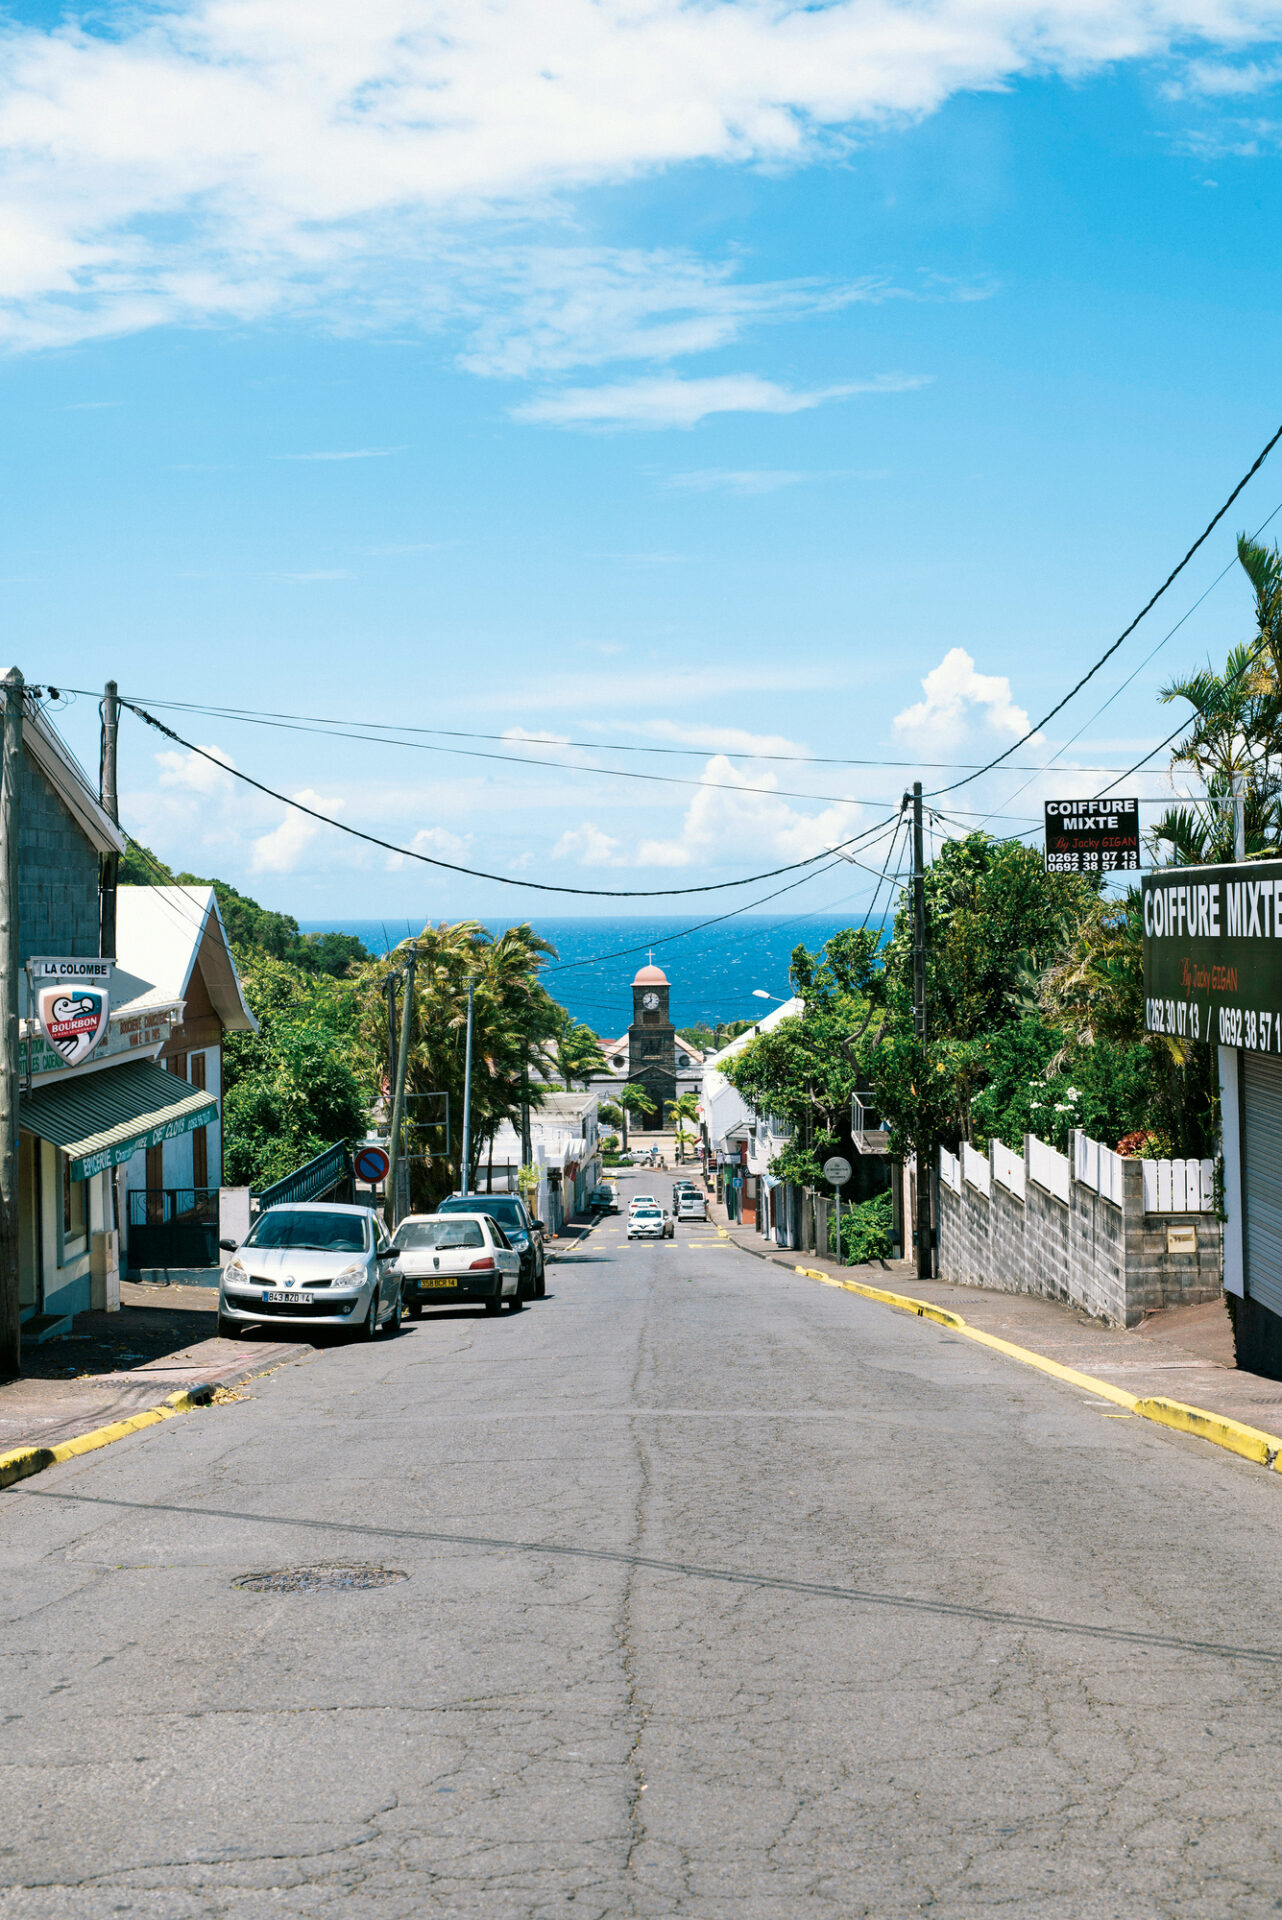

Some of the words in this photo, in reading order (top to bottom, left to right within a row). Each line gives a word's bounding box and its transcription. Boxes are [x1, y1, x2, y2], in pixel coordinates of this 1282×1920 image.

[1047, 800, 1135, 815] COIFFURE
[1063, 816, 1118, 830] MIXTE
[1053, 836, 1069, 853] By
[1072, 837, 1099, 850] Jacky
[1102, 836, 1137, 847] GIGAN
[1048, 852, 1079, 862] 0262
[1082, 852, 1098, 861] 30
[1102, 851, 1118, 861] 07
[1121, 851, 1137, 860] 13
[1048, 862, 1079, 872] 0692
[1082, 862, 1098, 871] 38
[1102, 861, 1118, 870] 57
[1121, 860, 1137, 870] 18
[1144, 883, 1221, 938] COIFFURE
[1226, 879, 1282, 938] MIXTE
[45, 963, 57, 974] LA
[60, 964, 107, 975] COLOMBE
[1193, 963, 1210, 997] Jacky
[1211, 965, 1238, 992] GIGAN
[52, 1016, 97, 1033] BOURBON
[1146, 997, 1165, 1033] 0262
[1165, 999, 1176, 1035] 30
[1177, 1001, 1187, 1036] 07
[1189, 1002, 1200, 1039] 13
[1219, 1006, 1243, 1047] 0692
[1244, 1009, 1257, 1050] 38
[1259, 1011, 1272, 1052] 57
[1275, 1012, 1282, 1053] 1
